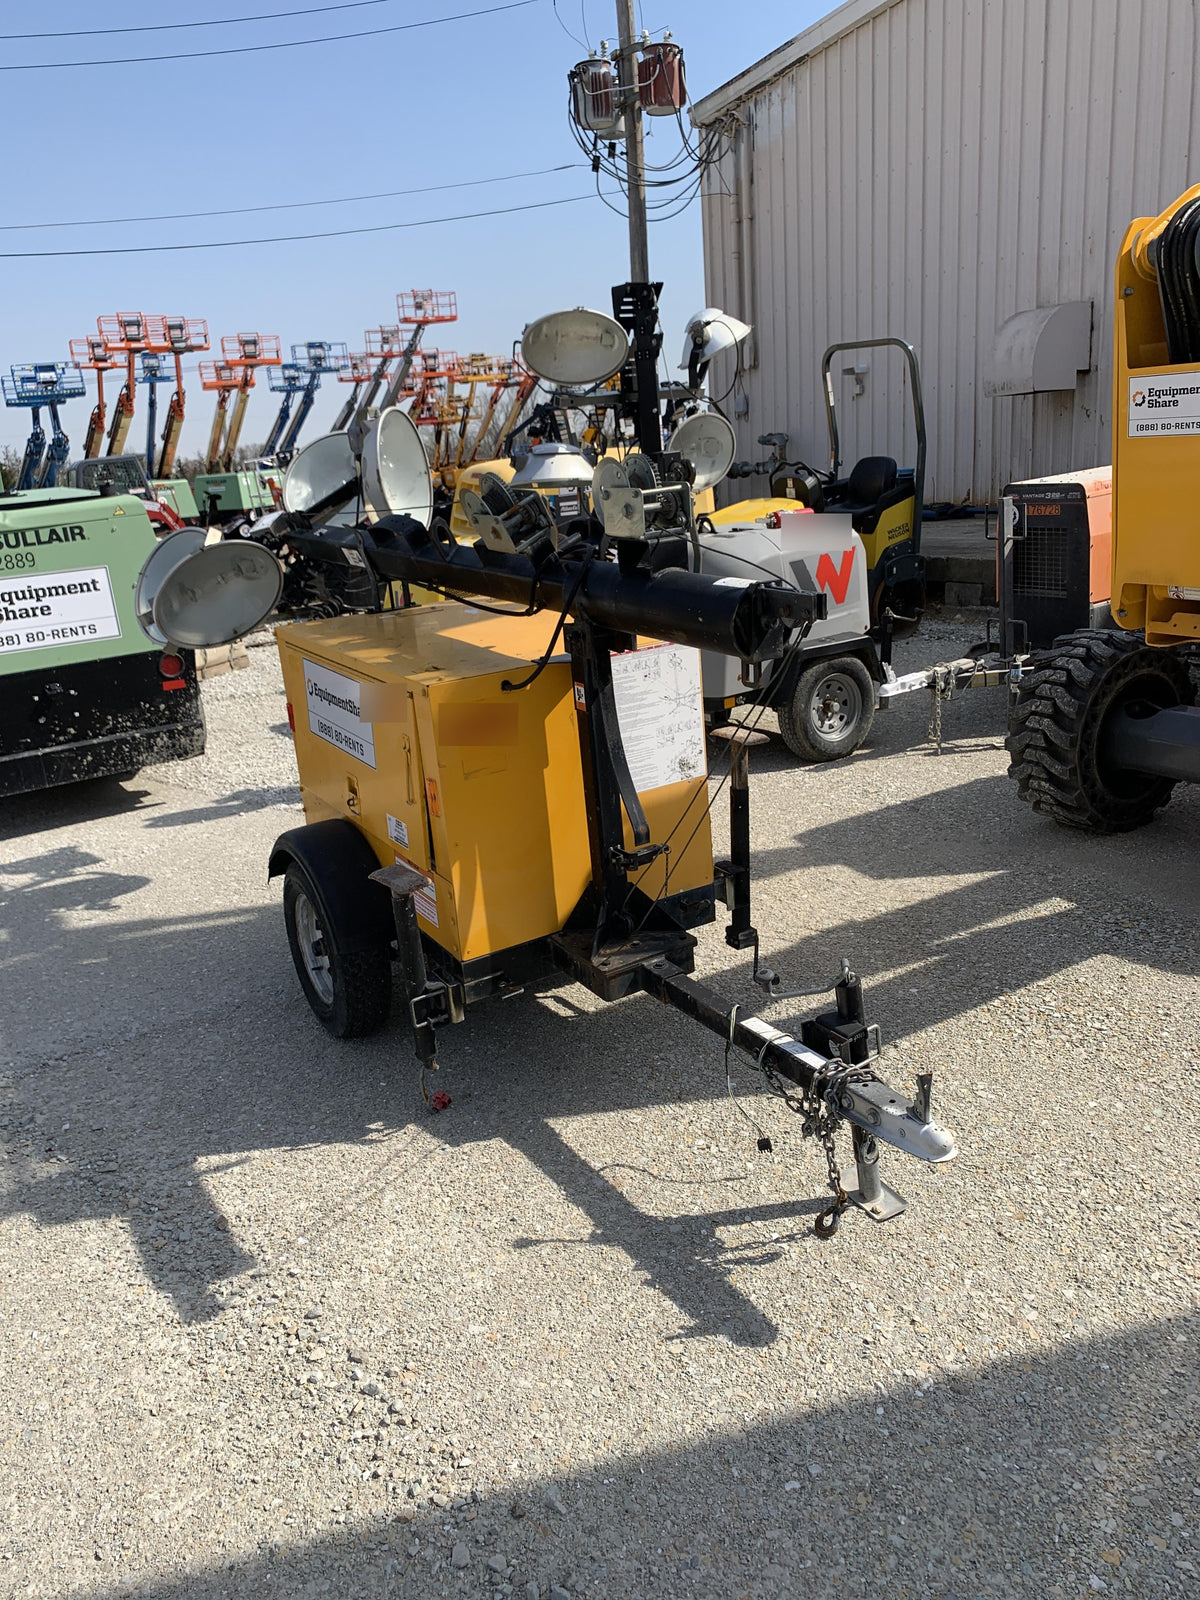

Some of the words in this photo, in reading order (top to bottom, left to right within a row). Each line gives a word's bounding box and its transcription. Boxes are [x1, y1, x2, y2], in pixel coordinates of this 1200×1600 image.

[1147, 398, 1179, 409] Share
[1136, 422, 1159, 432] (888)
[1160, 421, 1200, 431] 80-RENTS
[0, 578, 101, 606] quipment
[26, 624, 97, 643] 80-RENTS
[318, 719, 333, 739] (888)
[334, 730, 364, 756] 80-RENTS
